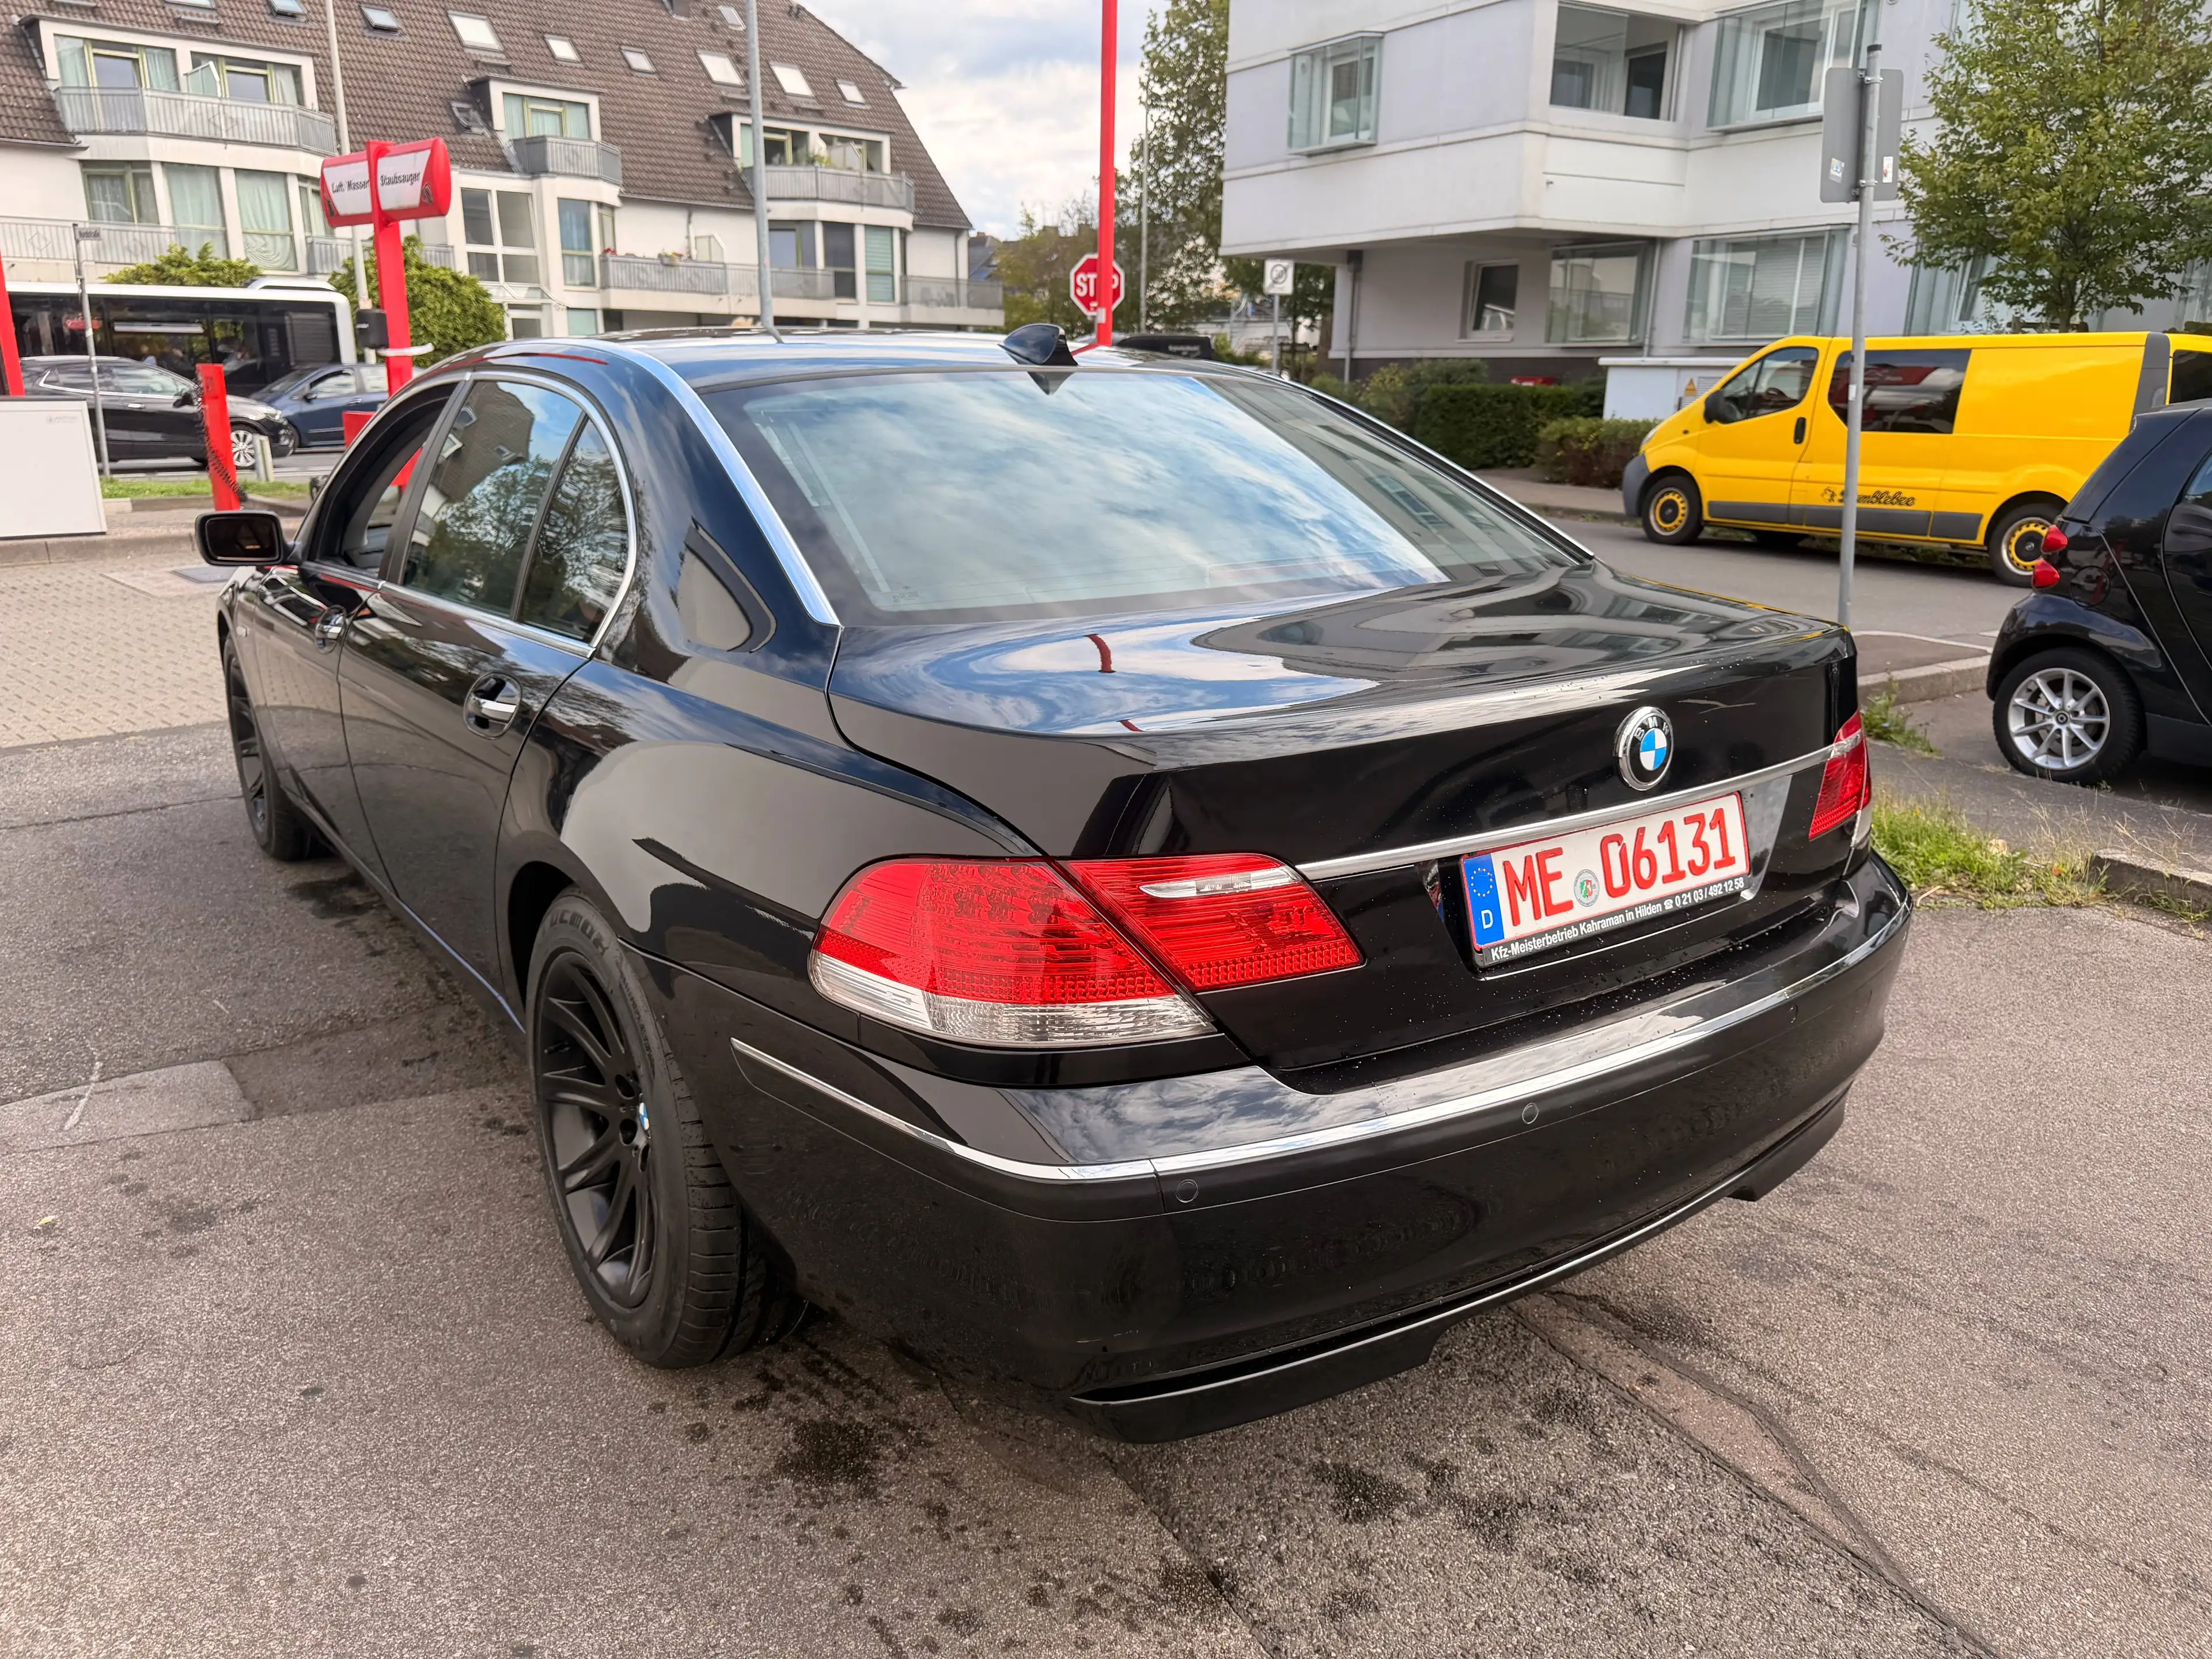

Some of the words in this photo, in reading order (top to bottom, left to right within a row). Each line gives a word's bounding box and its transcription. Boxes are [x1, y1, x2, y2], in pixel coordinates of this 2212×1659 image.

[380, 172, 421, 186] Staubsauger
[1075, 272, 1119, 297] STP
[1838, 490, 1916, 506] mblebee
[1634, 716, 1670, 741] BMW
[1502, 847, 1574, 927] ME
[1600, 808, 1736, 899] 06131
[1481, 909, 1494, 929] D
[1491, 925, 1578, 961] Kfz-Meisterbetrieb
[1579, 915, 1626, 935] Kahraman
[1625, 910, 1635, 922] in
[1635, 903, 1662, 919] Hilden
[1681, 893, 1692, 906] 21
[1693, 890, 1704, 903] 03
[1708, 884, 1723, 897] 492
[1723, 881, 1734, 893] 12
[1734, 877, 1744, 889] 58
